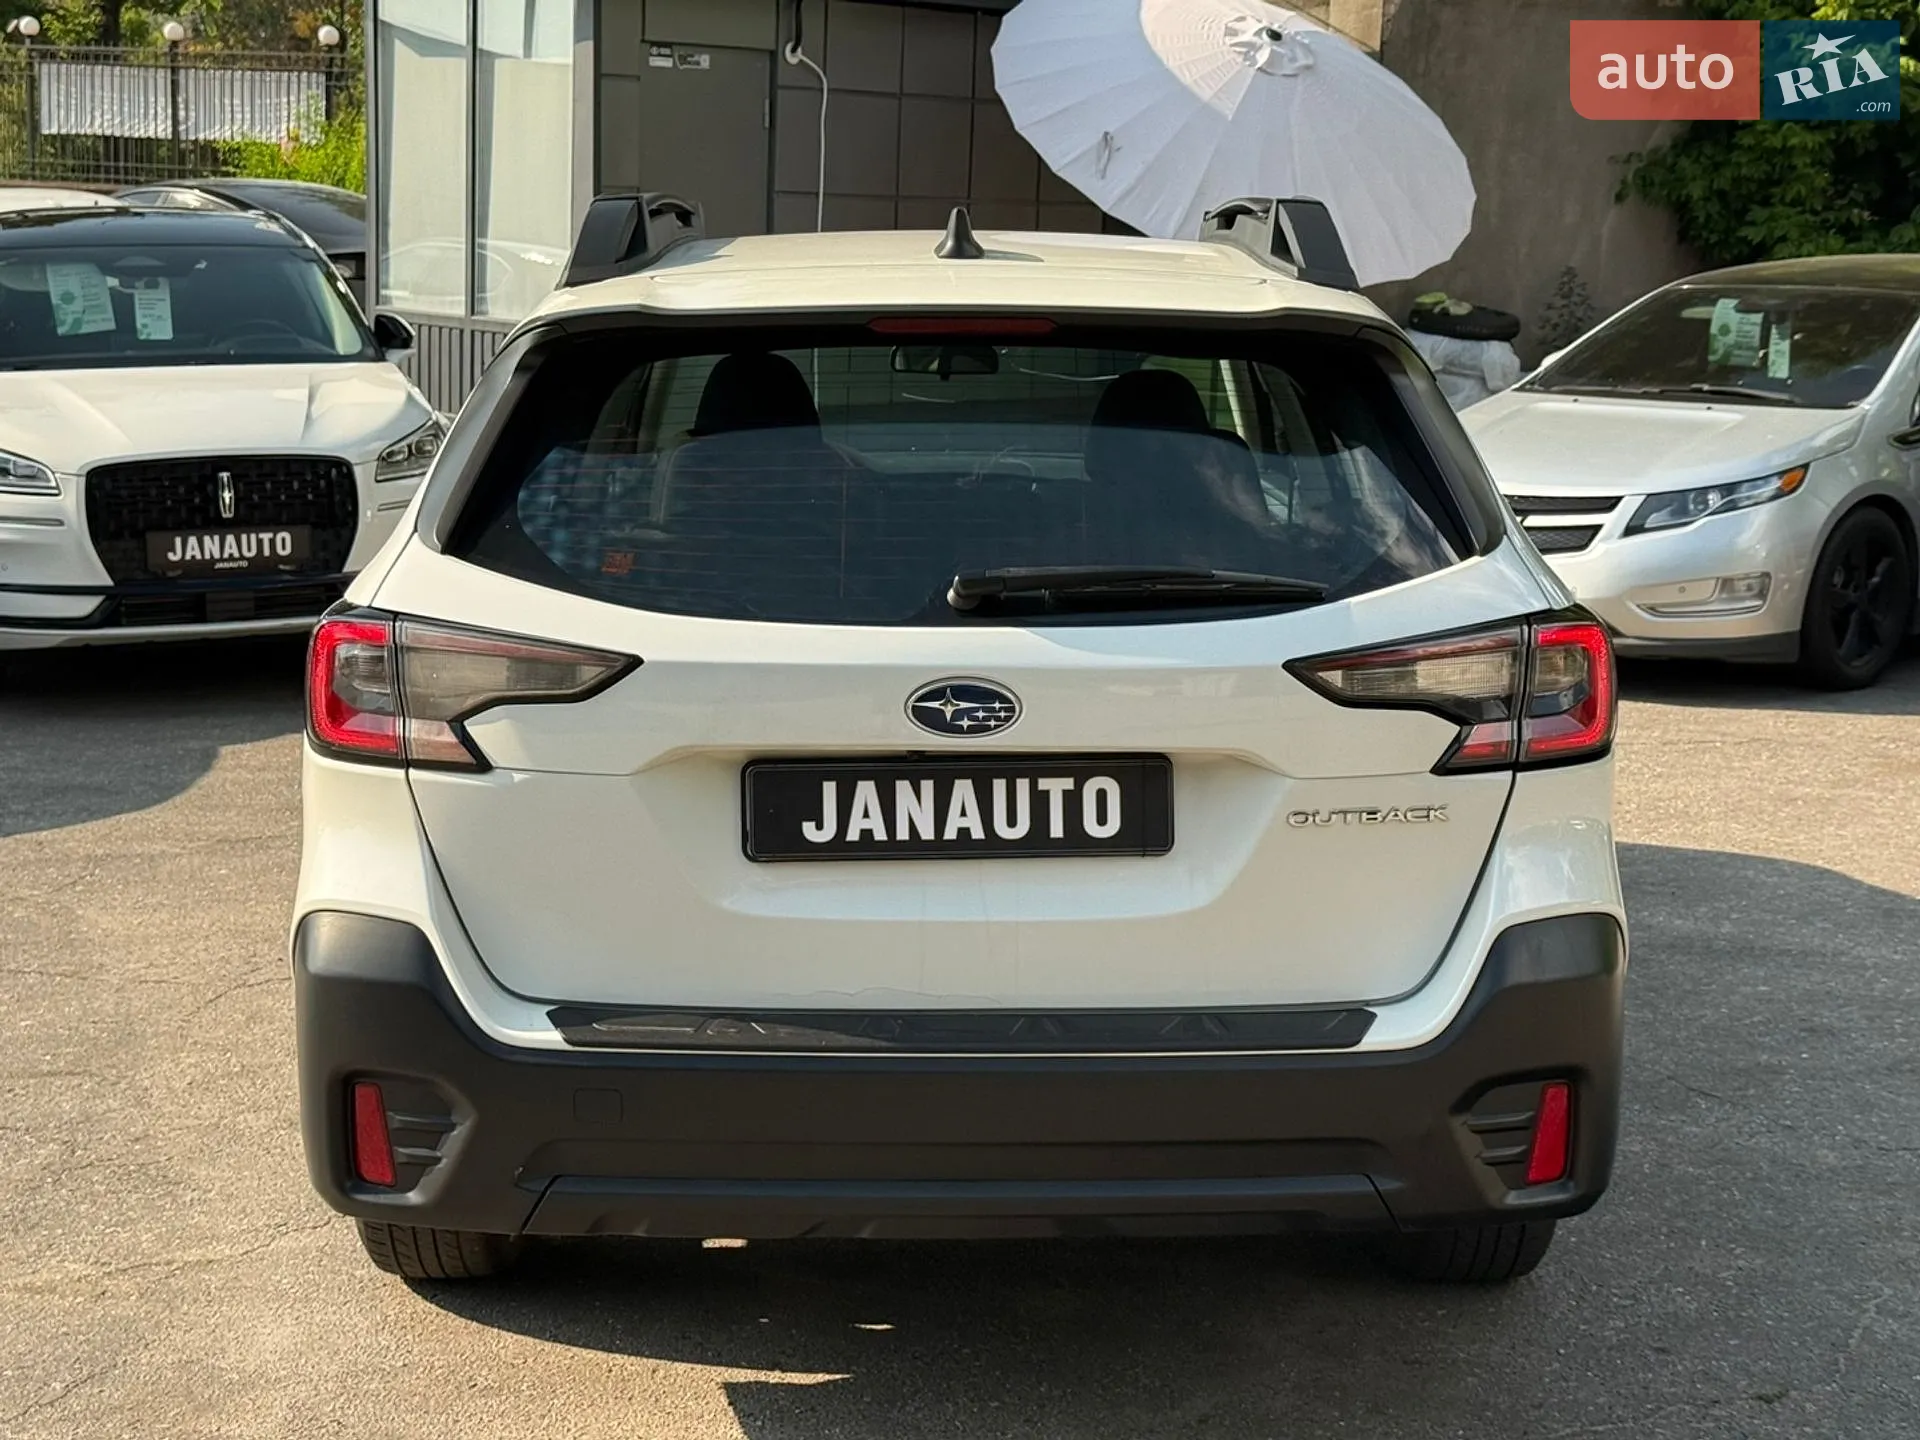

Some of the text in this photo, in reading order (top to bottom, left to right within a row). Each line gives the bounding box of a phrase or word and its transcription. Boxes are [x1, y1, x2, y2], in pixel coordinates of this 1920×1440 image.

[167, 531, 292, 561] JANAUTO
[214, 560, 249, 569] JANAUTO
[802, 775, 1122, 843] JANAUTO
[1285, 803, 1449, 828] OUTBACK
